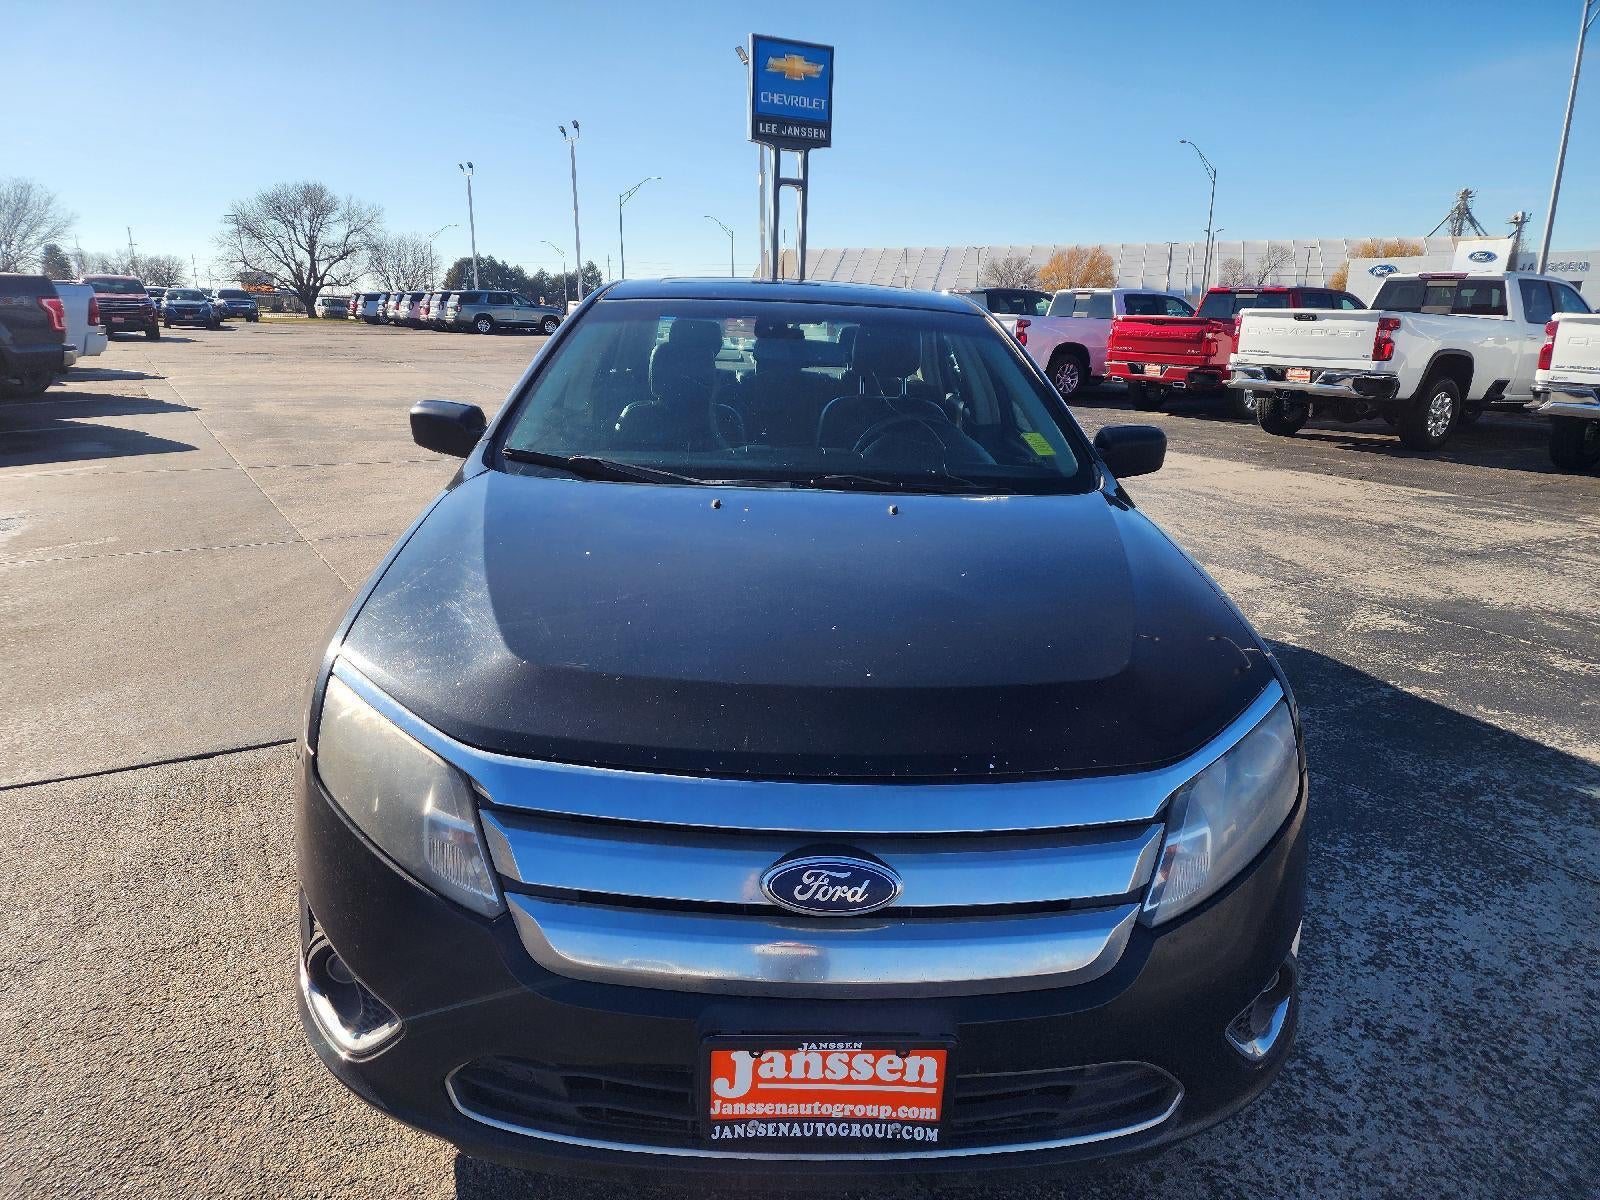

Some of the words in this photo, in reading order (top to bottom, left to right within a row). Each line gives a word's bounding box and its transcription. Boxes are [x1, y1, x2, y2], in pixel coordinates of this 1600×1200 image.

[760, 91, 827, 110] CHEVROLET
[759, 122, 778, 134] LEE
[781, 125, 826, 139] JANSSEN
[1519, 261, 1591, 272] JASSEN
[793, 869, 870, 903] Ford
[798, 1042, 863, 1052] JANSSEN
[713, 1050, 938, 1099] Janssen
[710, 1099, 937, 1120] Janssenautogroup.com
